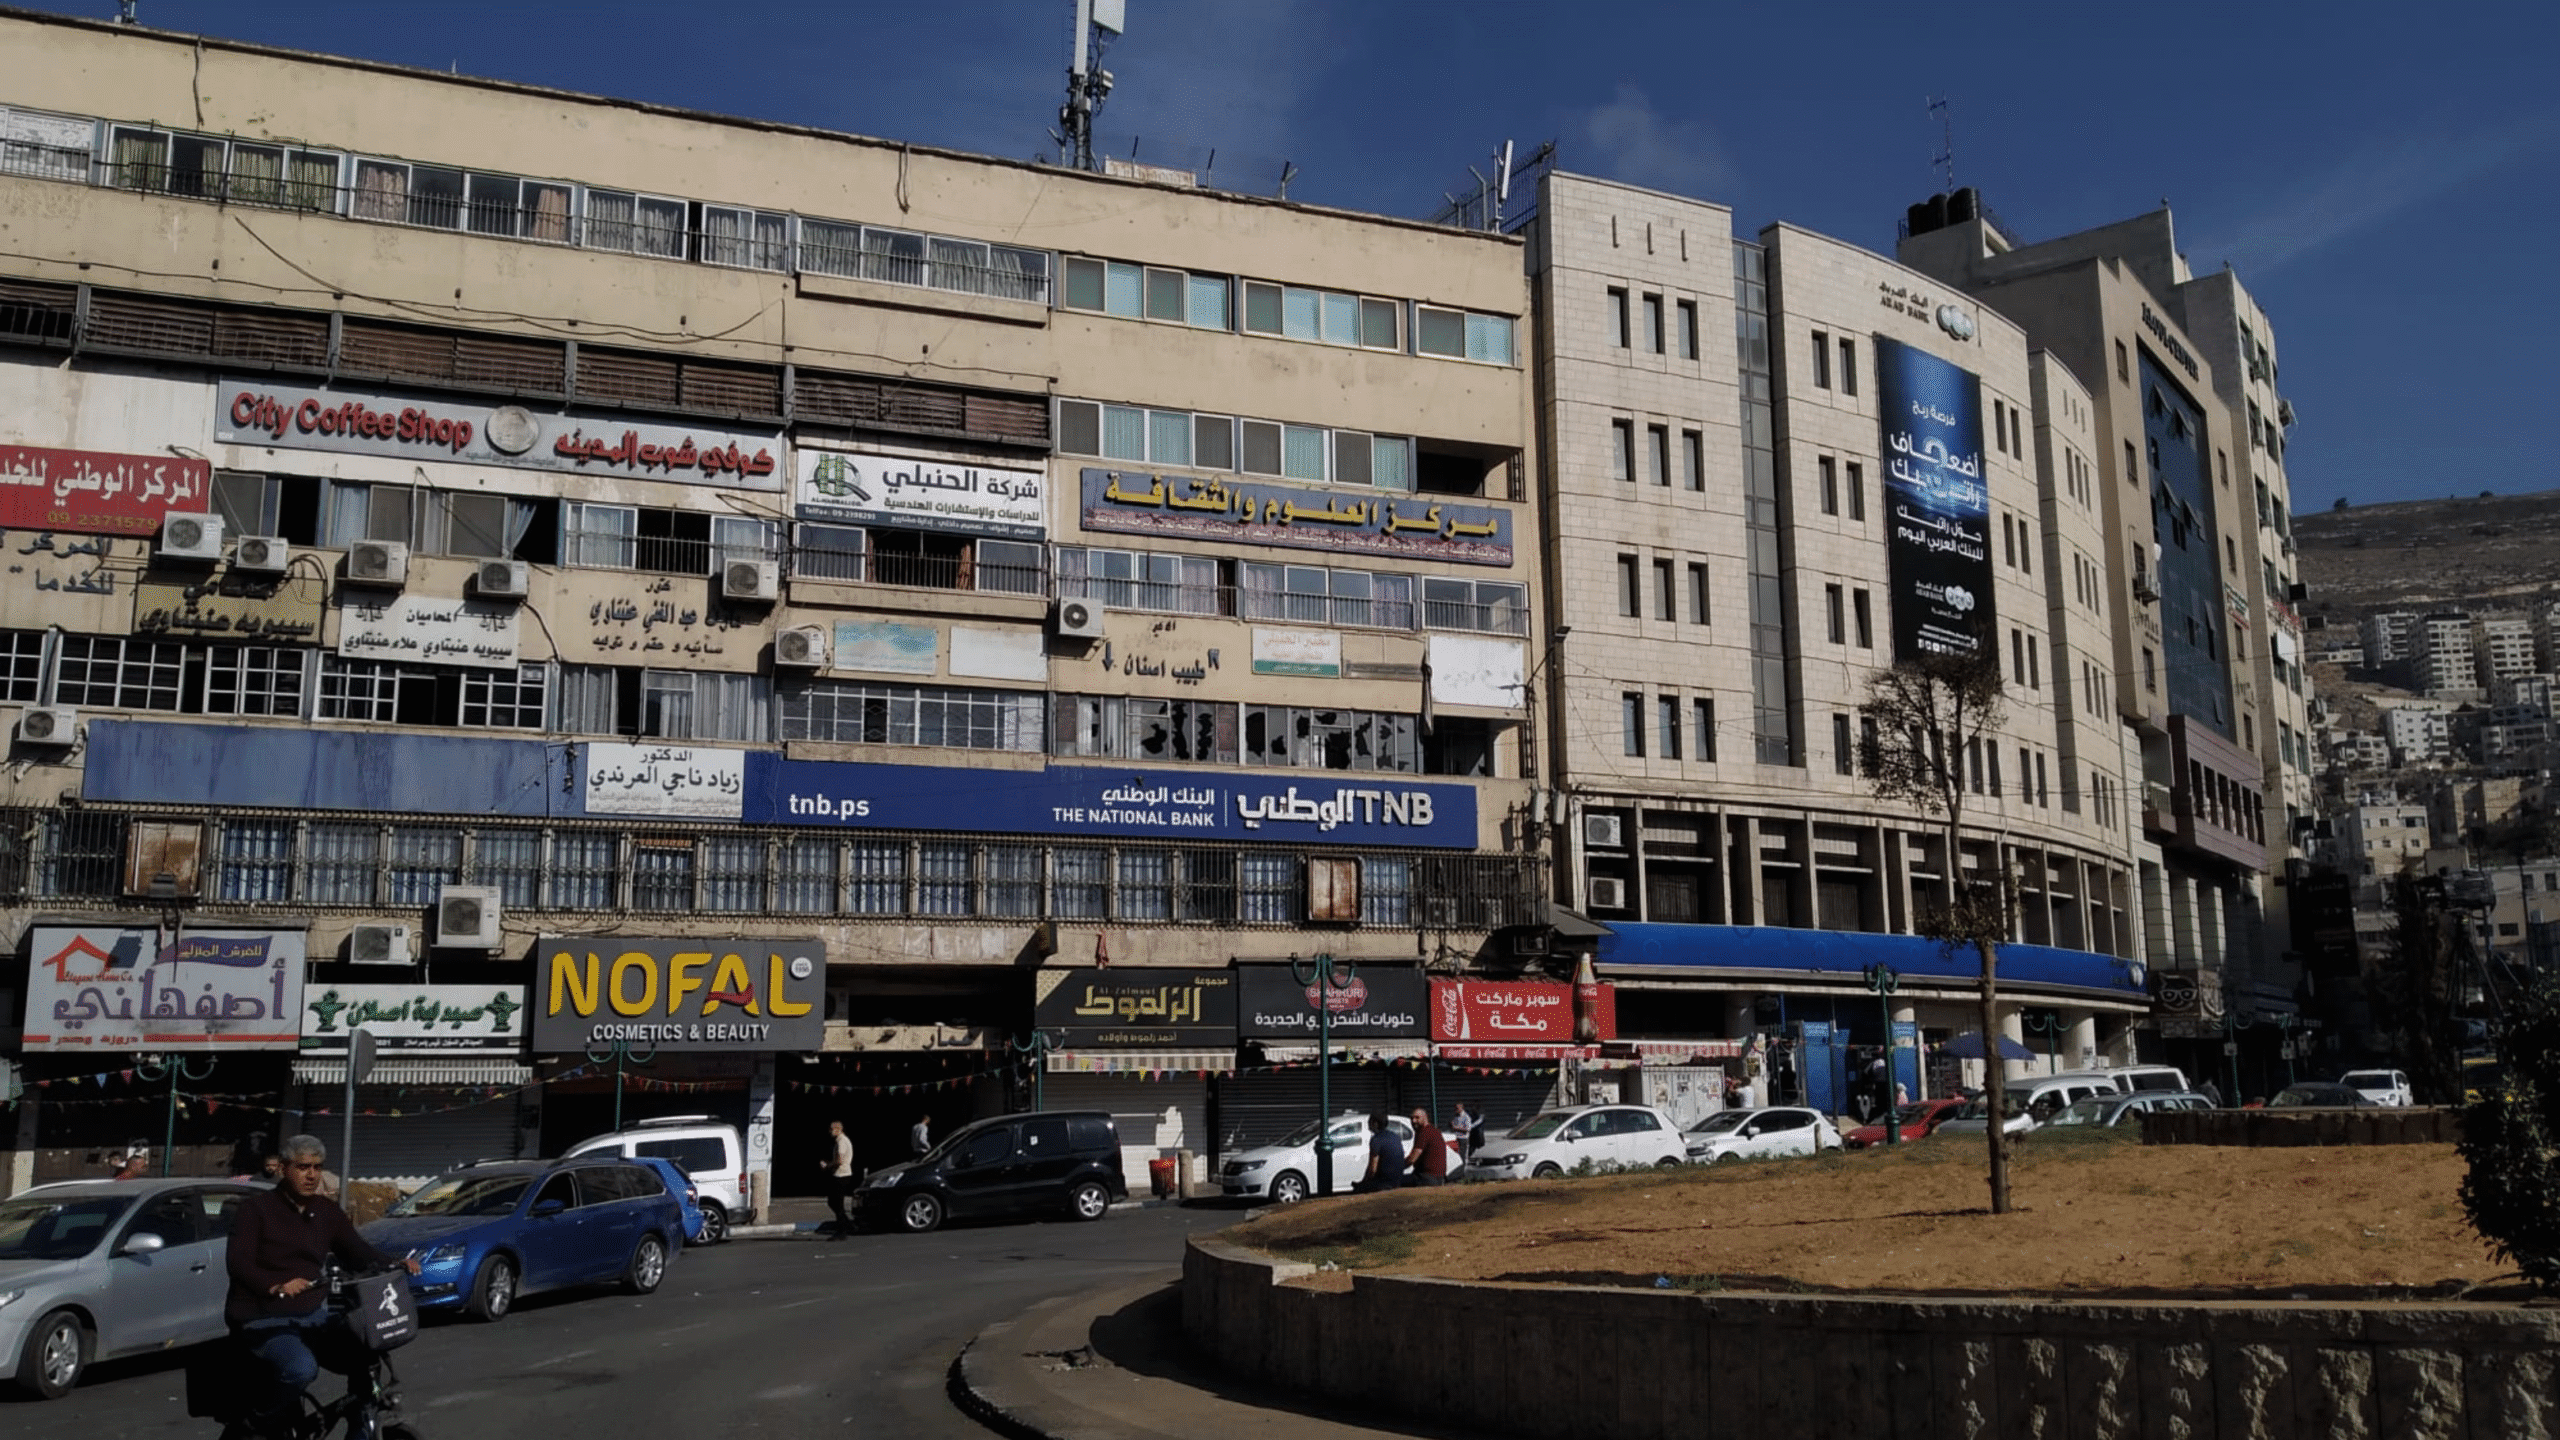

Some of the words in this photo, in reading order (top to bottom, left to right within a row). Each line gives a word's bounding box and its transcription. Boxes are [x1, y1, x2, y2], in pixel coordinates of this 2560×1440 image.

[232, 392, 294, 438] City
[298, 398, 396, 437] Coffee
[398, 406, 473, 452] Shop
[639, 437, 698, 472] شوب
[700, 440, 776, 478] كوفي
[54, 460, 133, 506] الوطني
[137, 462, 201, 504] المركز
[882, 464, 978, 494] الحنبلي
[987, 477, 1038, 501] شركة
[884, 497, 932, 511] الهندسية
[998, 509, 1039, 522] للدراسات
[1382, 502, 1498, 538] مركز
[639, 748, 693, 763] الدكتور
[589, 765, 658, 792] العرندي
[662, 767, 703, 796] ناجي
[708, 769, 740, 794] زياد
[789, 793, 871, 821] tnb.ps
[1101, 784, 1169, 807] الوطني
[1172, 787, 1216, 810] البنك
[1356, 790, 1434, 825] TNB
[1052, 807, 1085, 823] THE
[1089, 809, 1168, 826] NATIONAL
[1171, 811, 1215, 827] BANK
[1237, 787, 1355, 831] الوطني
[54, 958, 285, 1029] أصفهاني
[550, 952, 812, 1017] NOFAL
[1075, 985, 1202, 1022] الزلموط
[1476, 992, 1523, 1008] ماركت
[1526, 994, 1560, 1008] سوبر
[593, 1024, 683, 1042] COSMETICS
[690, 1025, 700, 1040] &
[707, 1024, 770, 1041] BEAUTY
[1255, 1012, 1304, 1028] الجديدة
[1306, 1011, 1369, 1030] الشحري
[1370, 1012, 1414, 1028] حلويات
[1490, 1010, 1547, 1031] مكة
